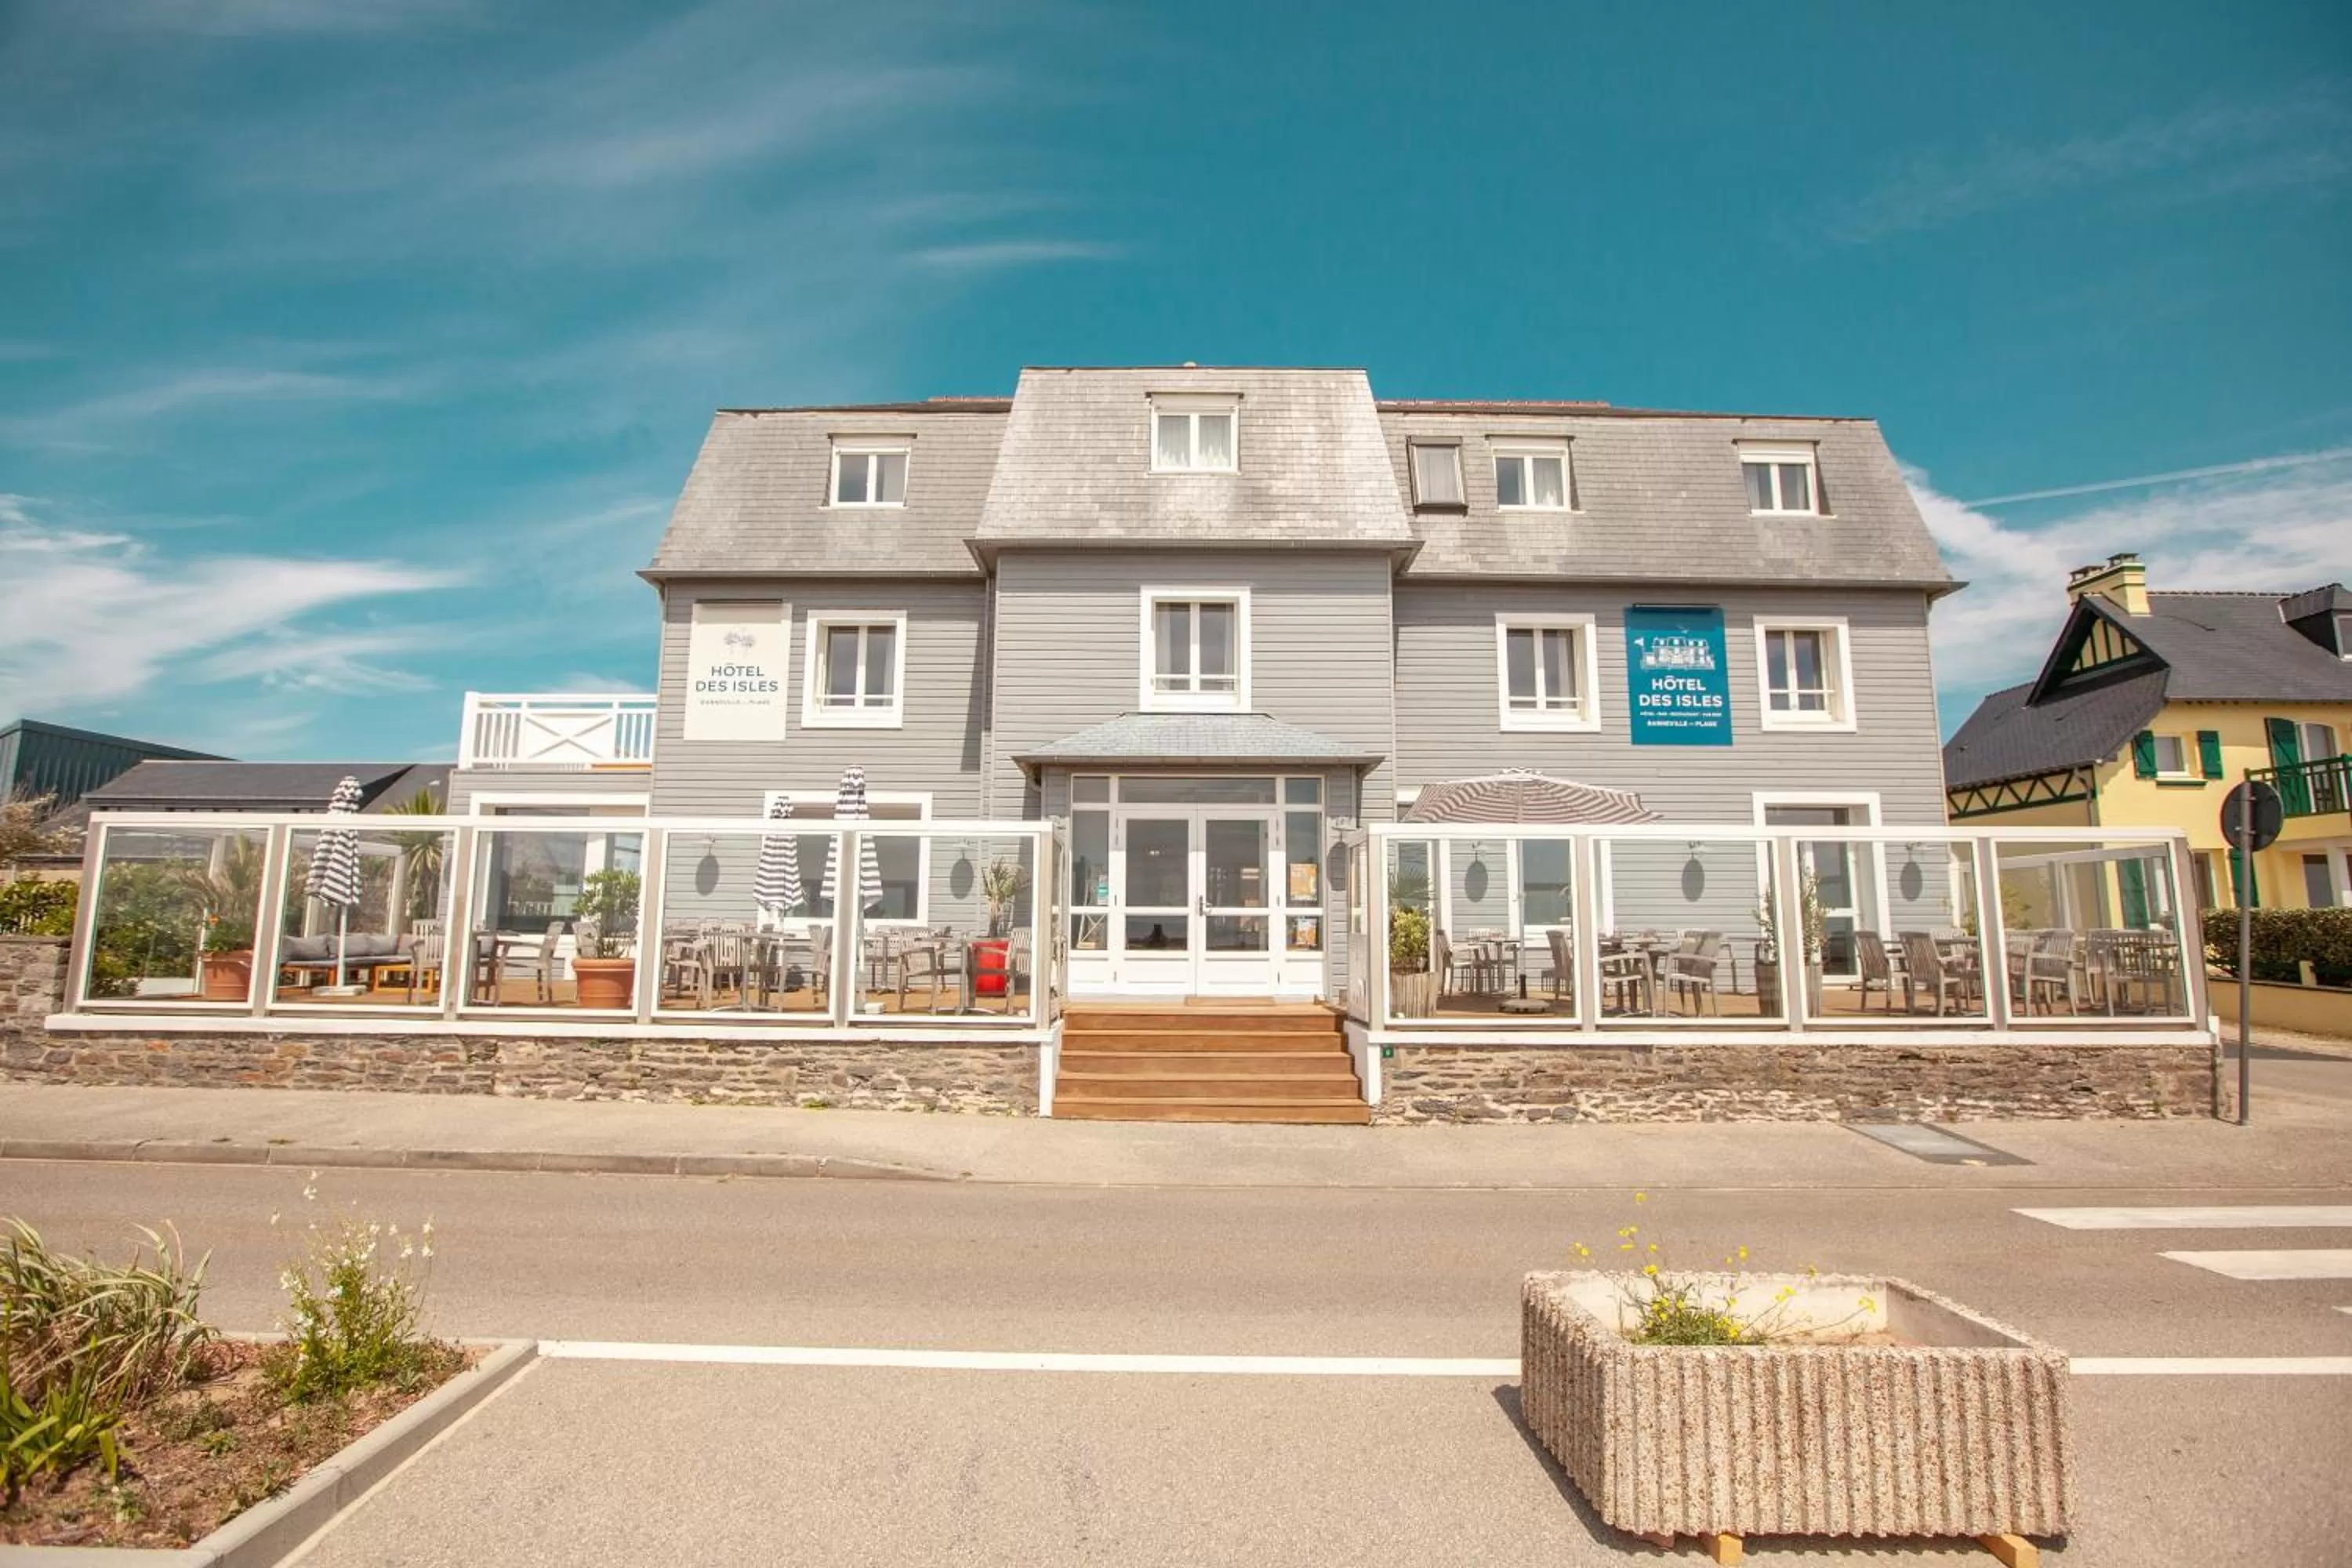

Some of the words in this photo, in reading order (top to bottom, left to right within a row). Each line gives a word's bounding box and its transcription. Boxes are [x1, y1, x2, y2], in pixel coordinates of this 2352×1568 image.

[711, 662, 765, 677] HÔTEL
[695, 681, 728, 691] DES
[733, 681, 779, 691] ISLES
[1652, 675, 1706, 691] HÔTEL
[1639, 694, 1671, 706] DES
[1676, 695, 1722, 707] ISLES
